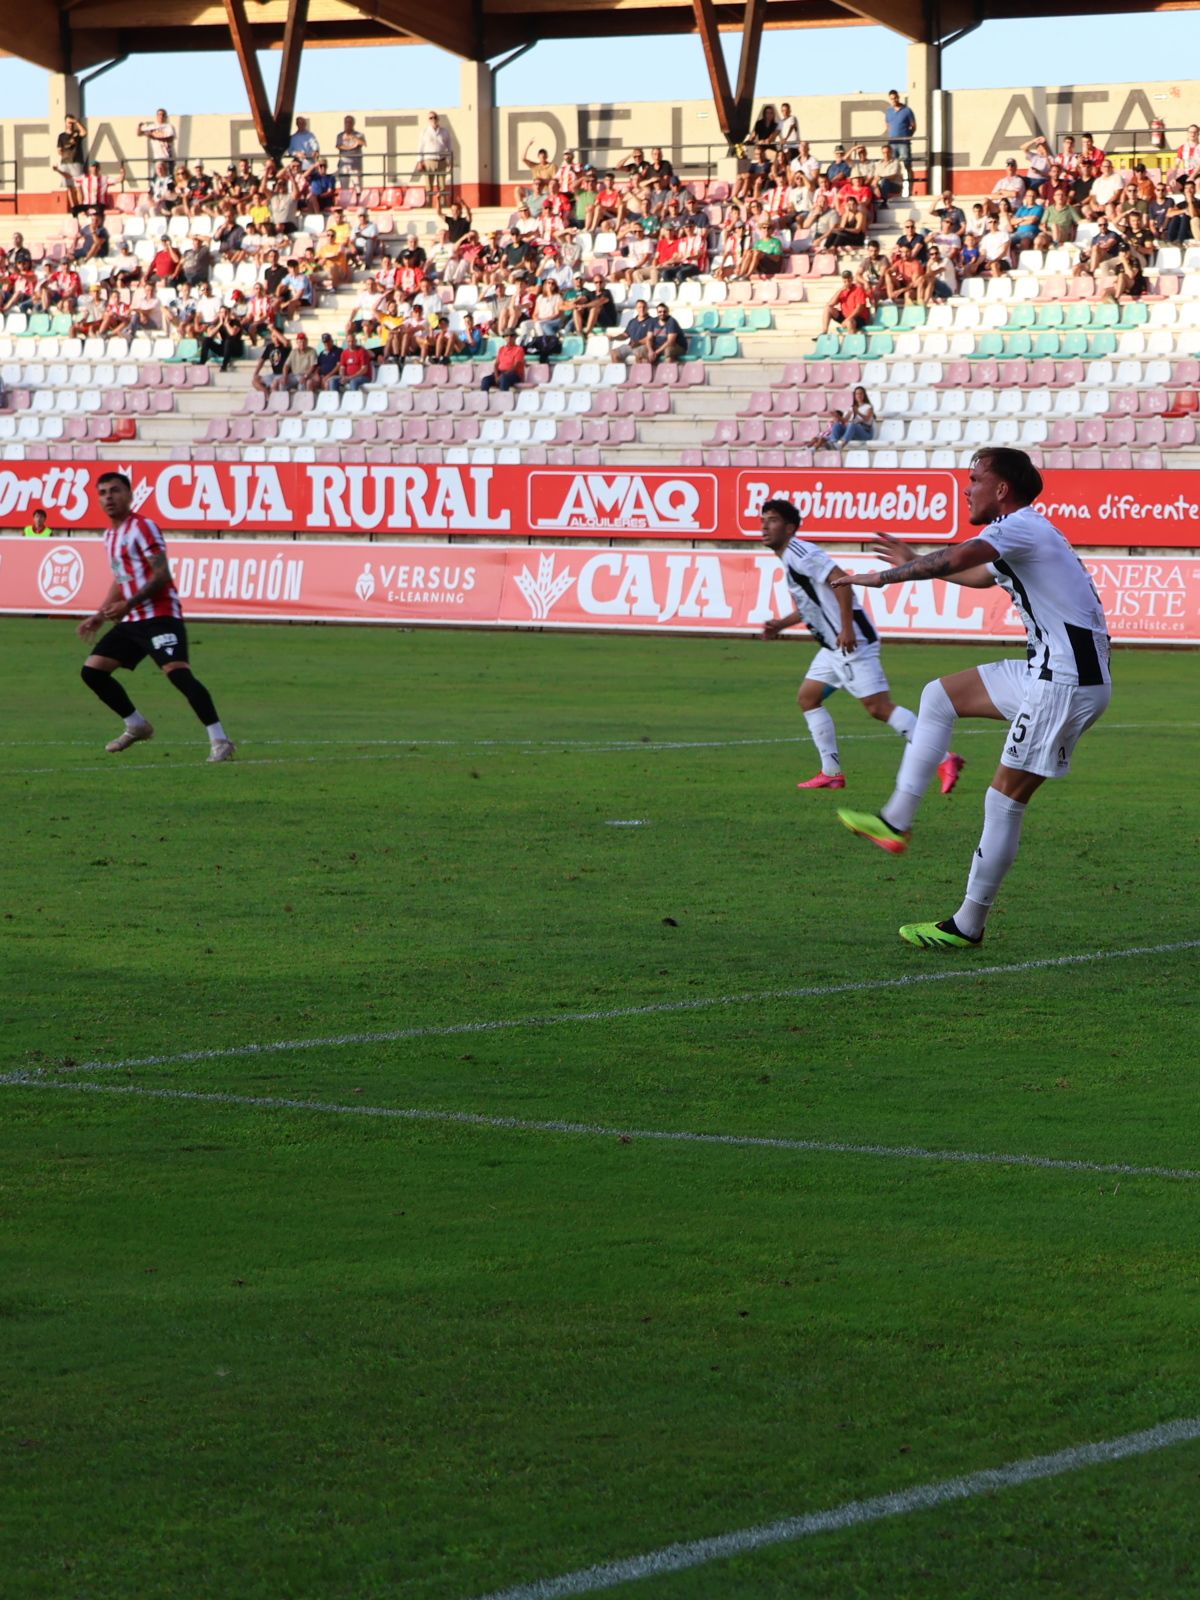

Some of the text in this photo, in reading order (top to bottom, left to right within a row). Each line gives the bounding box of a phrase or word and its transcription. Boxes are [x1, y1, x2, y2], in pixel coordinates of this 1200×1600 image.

[155, 463, 511, 529] CAJA RURAL
[537, 474, 699, 530] AMAQ
[1030, 493, 1200, 521] orma diferente
[570, 518, 647, 529] ALQUILERES
[379, 564, 477, 591] VERSUS
[577, 552, 984, 631] CAJA RRAL
[387, 591, 465, 604] E-LEARNING
[1012, 712, 1031, 743] 5
